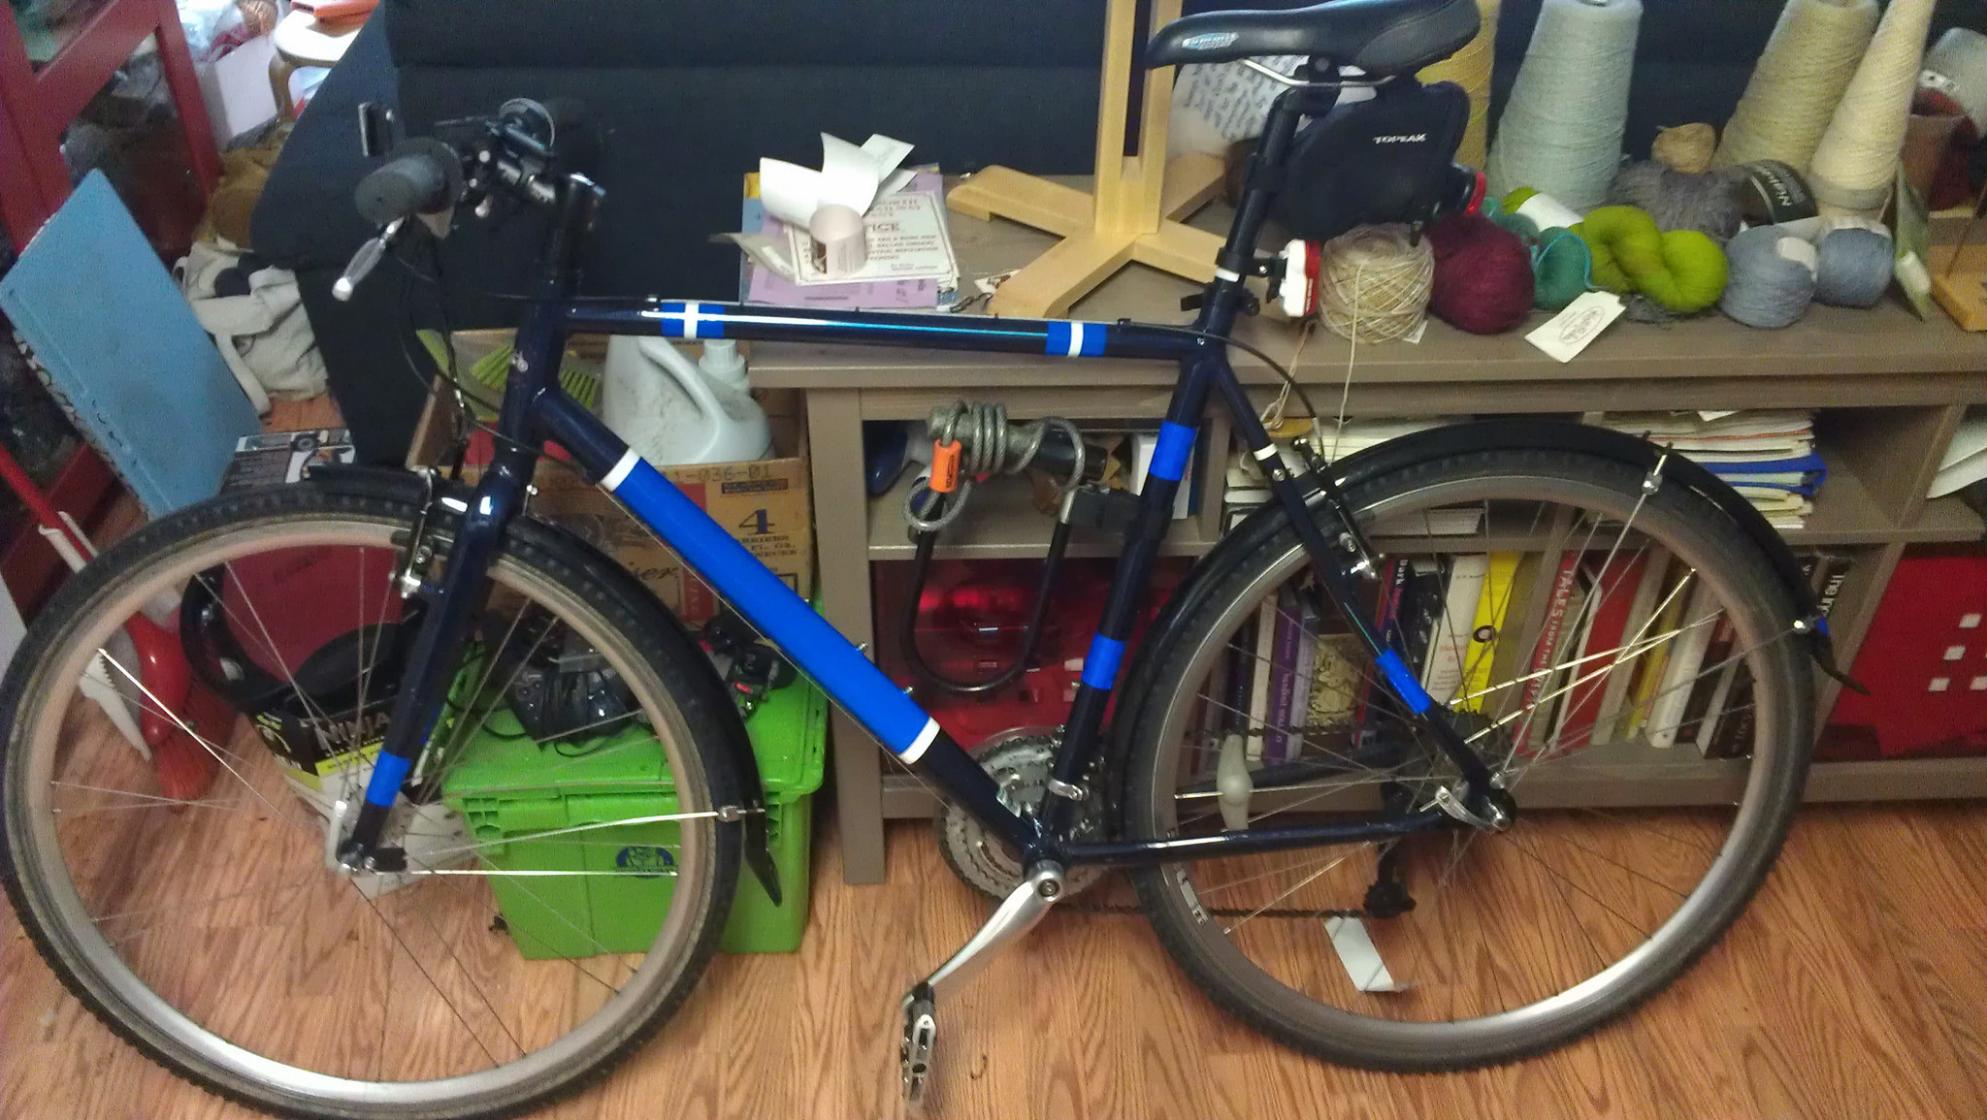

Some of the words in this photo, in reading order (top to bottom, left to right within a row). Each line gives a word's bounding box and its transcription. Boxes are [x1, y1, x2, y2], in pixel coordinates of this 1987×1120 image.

[1372, 132, 1427, 144] TOPEAK
[738, 508, 776, 535] 4
[1551, 570, 1573, 617] TALES
